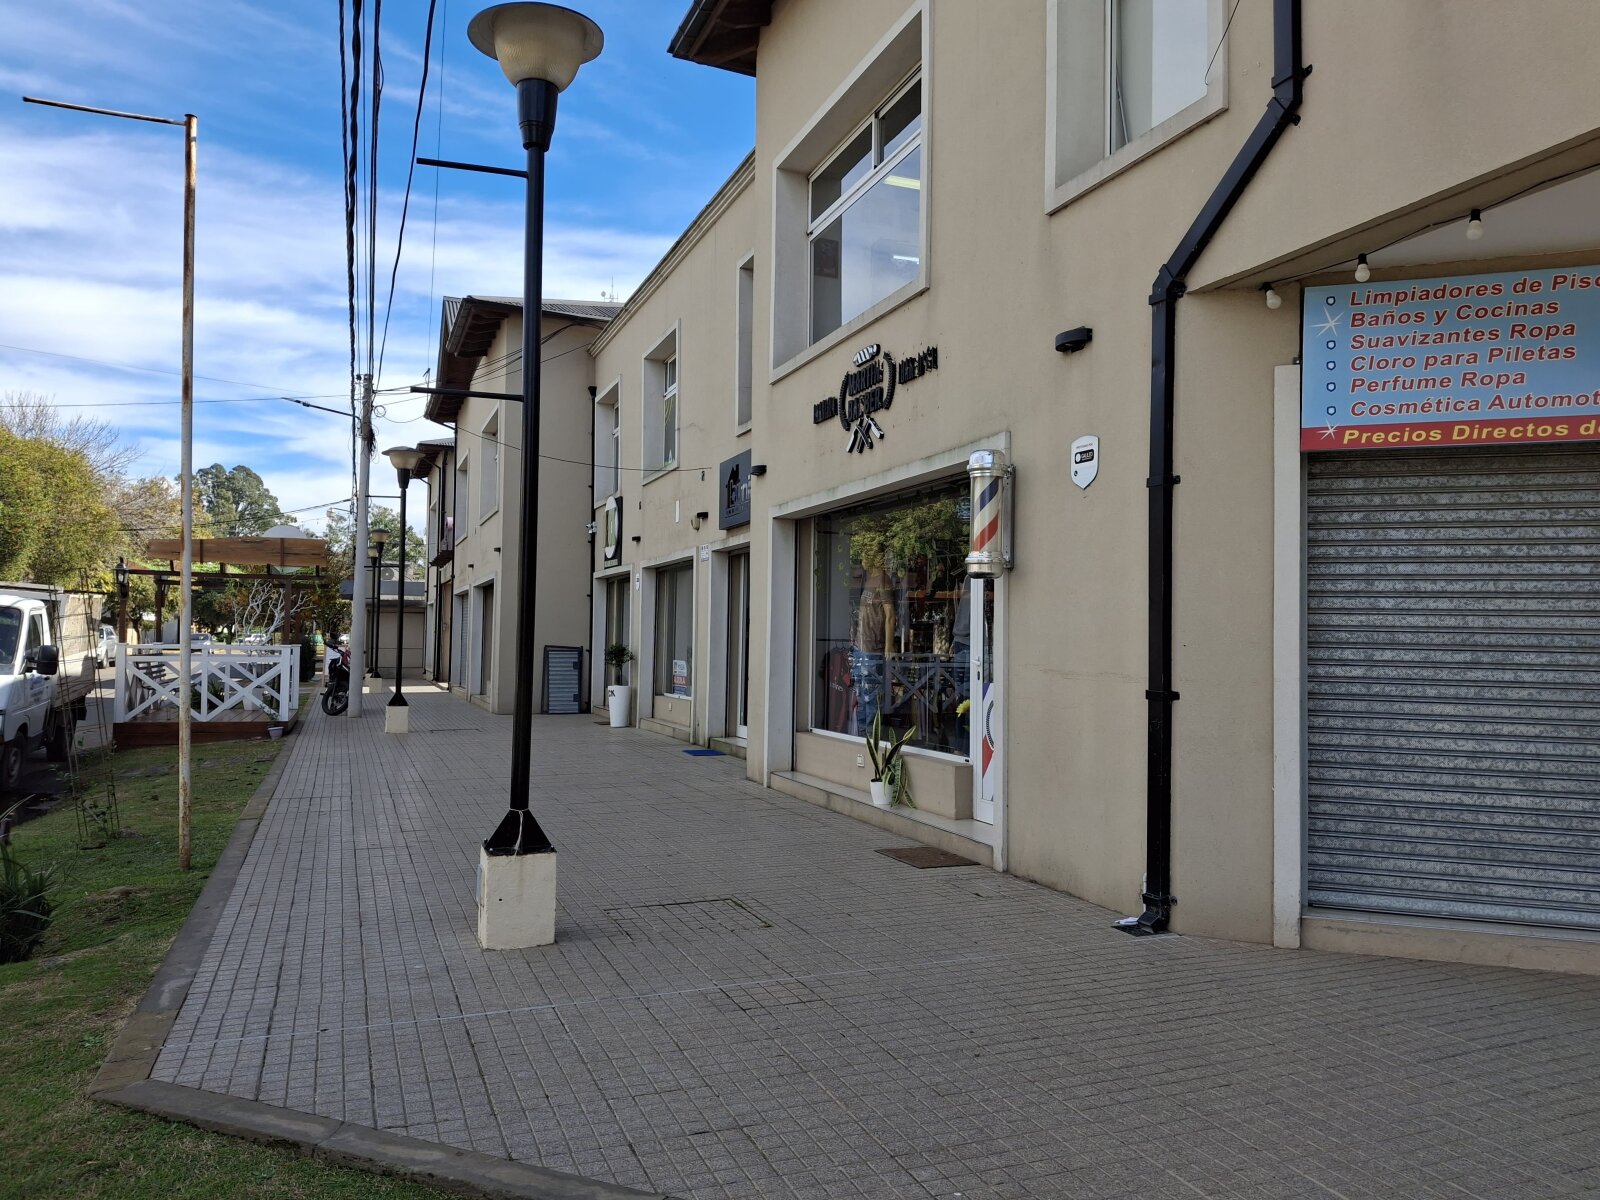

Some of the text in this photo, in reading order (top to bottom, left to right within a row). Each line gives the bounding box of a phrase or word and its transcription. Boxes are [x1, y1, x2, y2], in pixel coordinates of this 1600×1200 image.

[1350, 283, 1503, 307] Limpiadores
[1512, 277, 1543, 295] de
[1350, 301, 1559, 328] Baños y Cocinas
[1350, 322, 1577, 350] Suavizantes Ropa
[1350, 345, 1577, 372] Cloro para Piletas
[1350, 370, 1527, 393] Perfume Ropa
[1350, 396, 1480, 417] Cosmética
[1343, 419, 1600, 445] Precios Directos d
